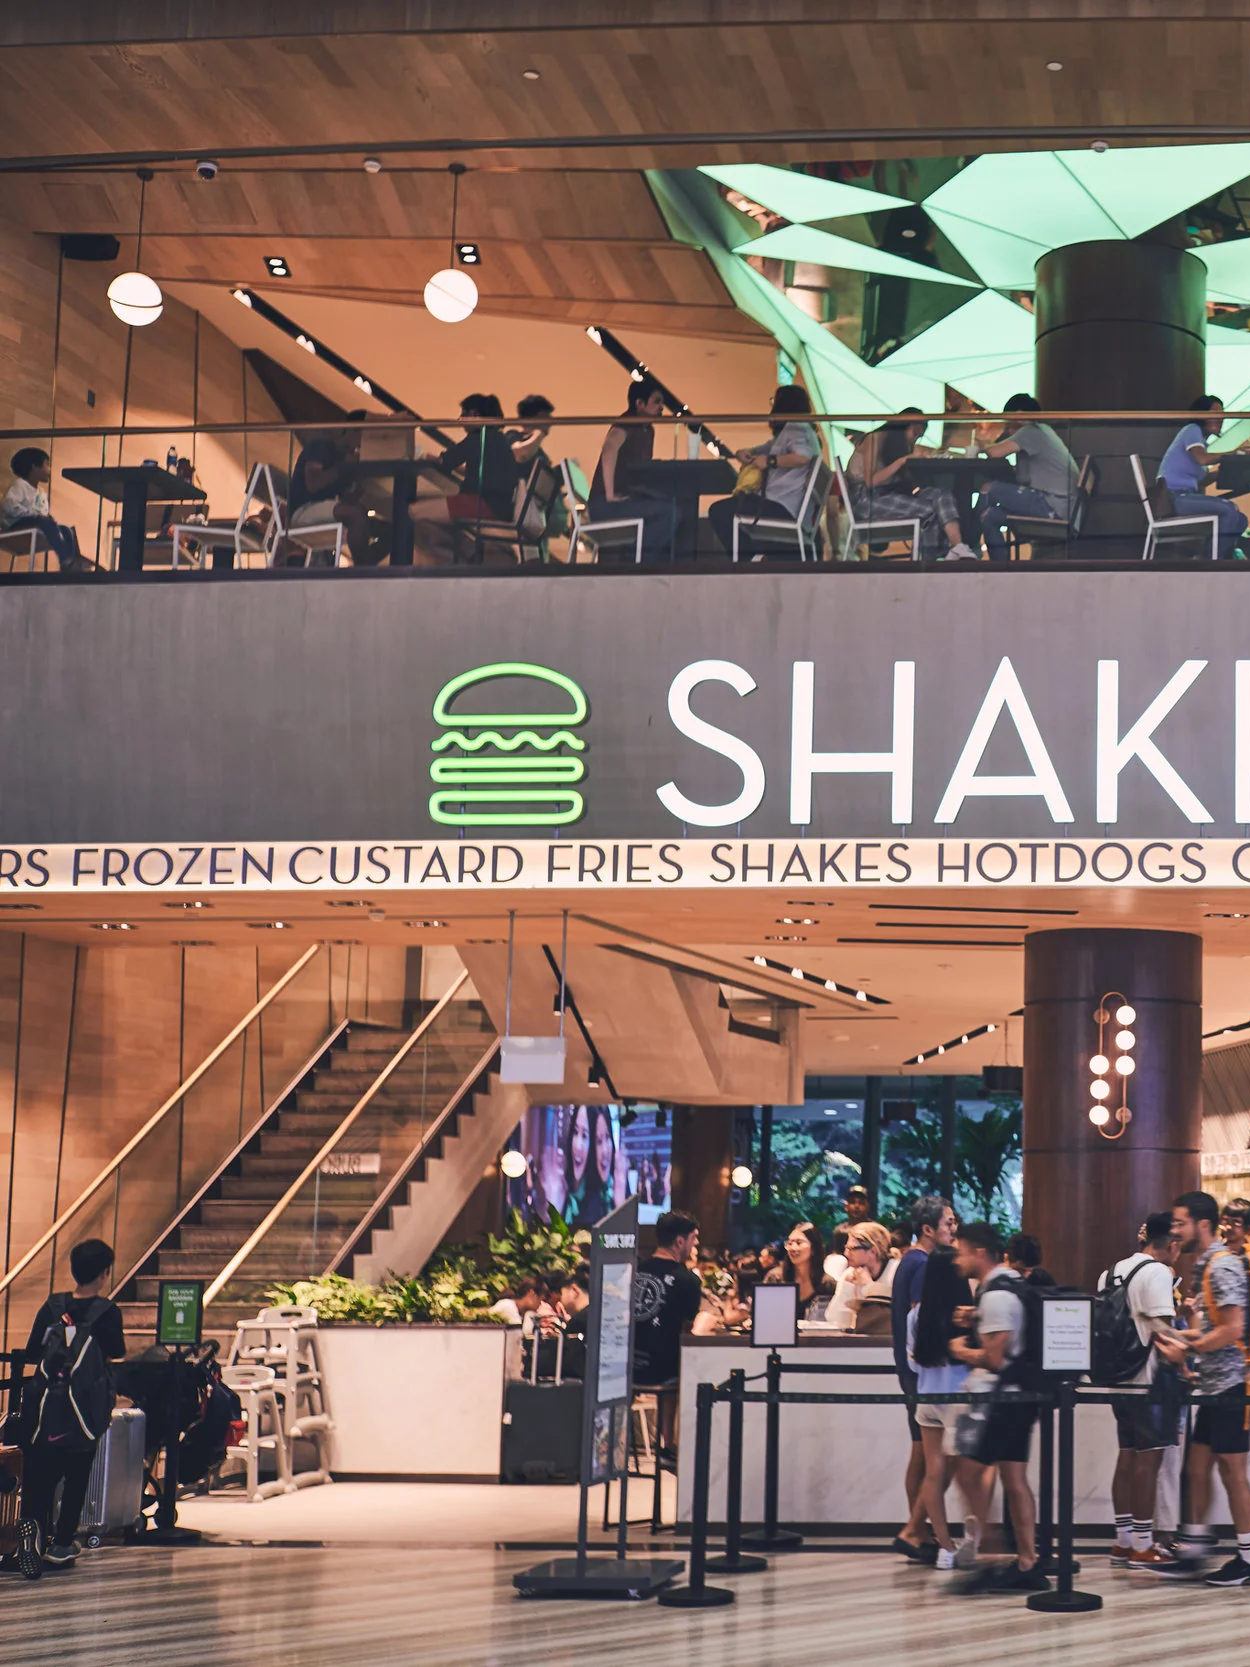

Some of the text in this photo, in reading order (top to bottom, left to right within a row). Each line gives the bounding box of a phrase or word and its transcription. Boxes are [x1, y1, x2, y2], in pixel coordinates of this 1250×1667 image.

[72, 847, 275, 887] FROZEN
[289, 845, 524, 886] CUSTARD
[547, 844, 684, 884] FRIES
[709, 842, 912, 884] SHAKES
[938, 842, 1207, 884] HOTDOGS
